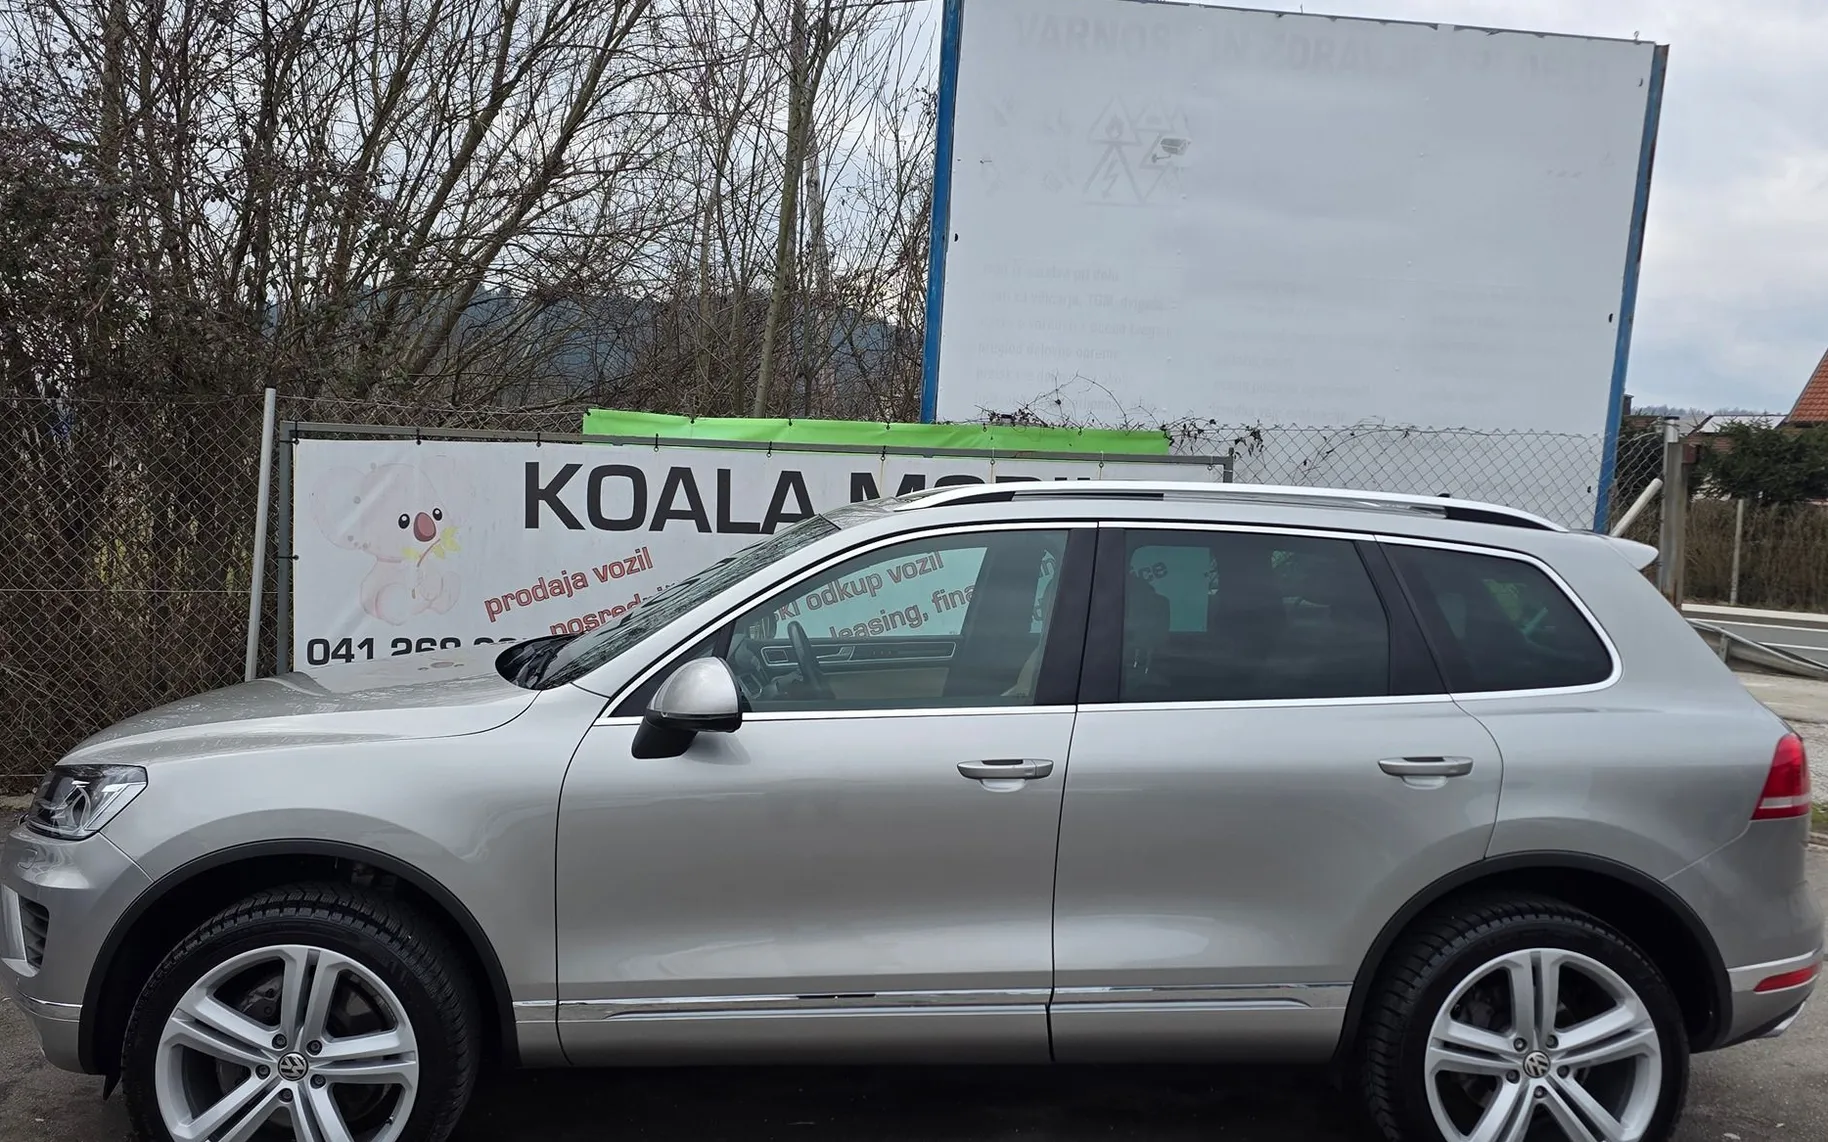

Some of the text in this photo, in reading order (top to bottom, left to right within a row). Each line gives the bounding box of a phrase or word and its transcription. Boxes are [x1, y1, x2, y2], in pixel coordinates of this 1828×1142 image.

[524, 461, 816, 535] KOALA
[484, 546, 653, 623] prodaja vozil
[805, 573, 883, 611] odkup
[887, 550, 944, 584] vozil
[306, 637, 375, 666] 041
